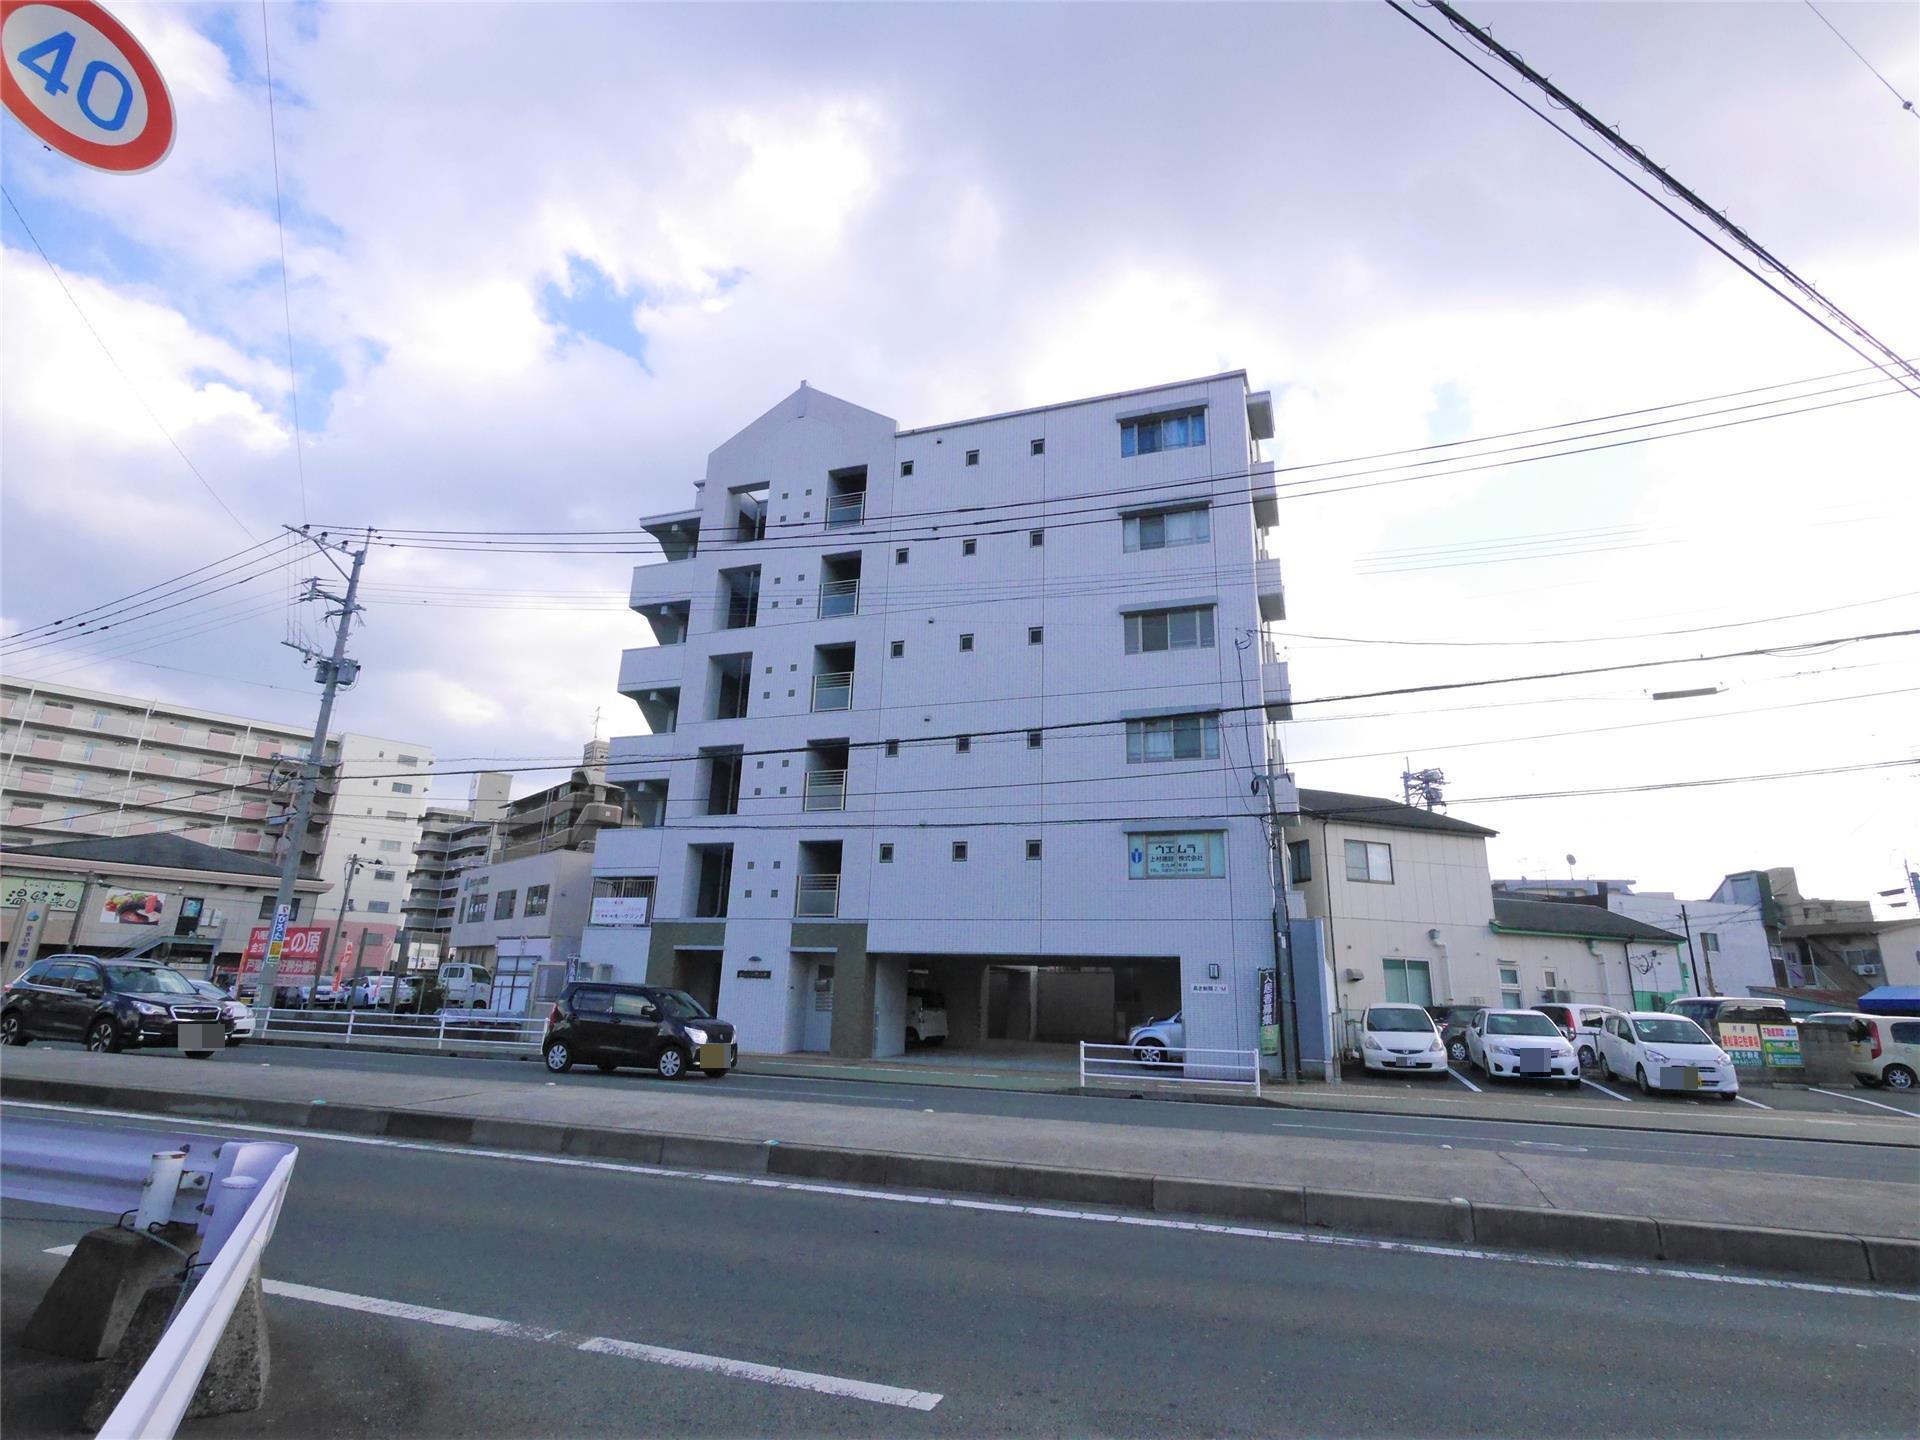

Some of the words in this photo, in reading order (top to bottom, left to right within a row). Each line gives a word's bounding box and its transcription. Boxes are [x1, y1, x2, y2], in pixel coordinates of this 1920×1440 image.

[17, 31, 134, 132] 40
[1156, 844, 1196, 854] ウエムラ
[1262, 976, 1273, 1025] 入居者募集
